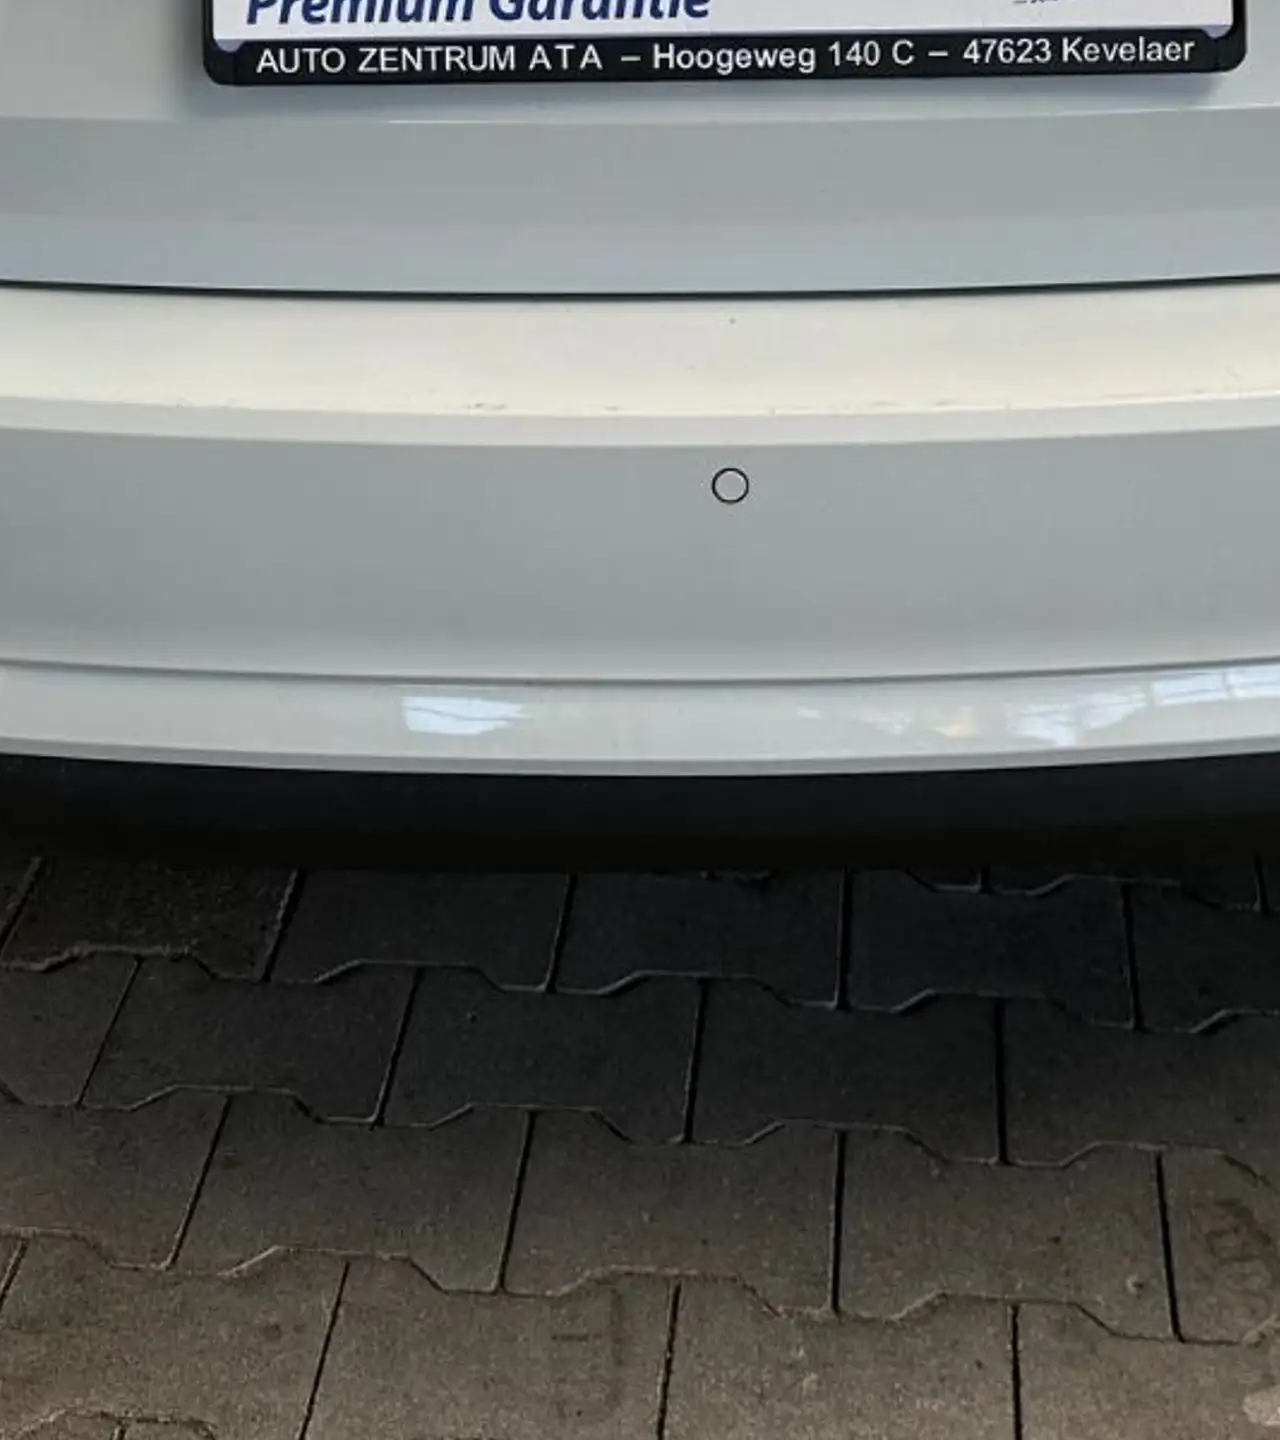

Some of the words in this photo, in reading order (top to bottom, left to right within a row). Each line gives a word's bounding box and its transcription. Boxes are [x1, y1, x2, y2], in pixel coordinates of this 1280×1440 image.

[256, 47, 347, 74] AUTO
[357, 44, 517, 73] ZENTRUM
[652, 42, 817, 75] Hoogeweg
[828, 40, 881, 67] 140
[891, 39, 916, 66] C
[962, 37, 1053, 64] 47623
[1062, 35, 1196, 63] Kevelaer
